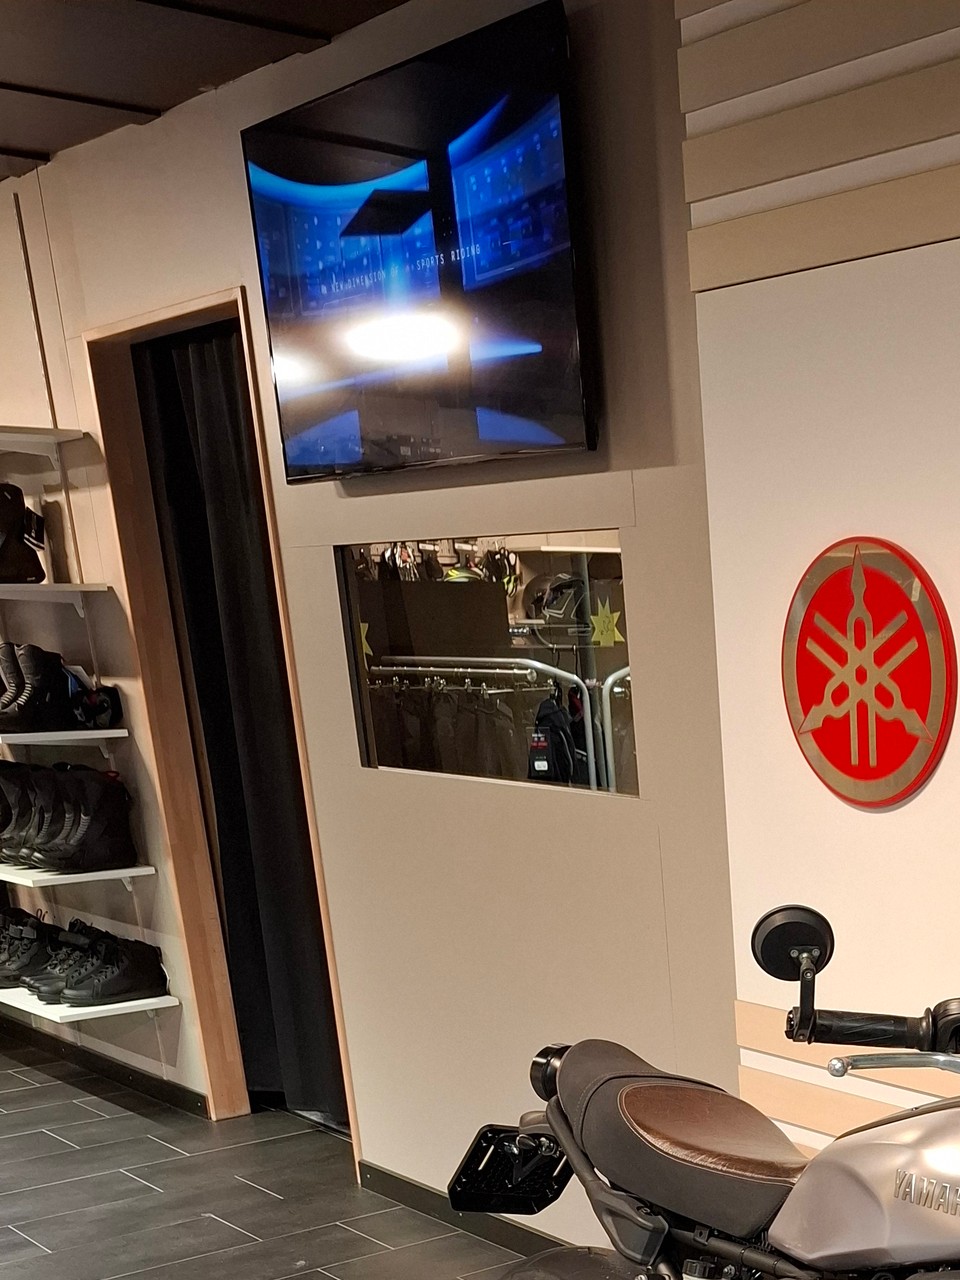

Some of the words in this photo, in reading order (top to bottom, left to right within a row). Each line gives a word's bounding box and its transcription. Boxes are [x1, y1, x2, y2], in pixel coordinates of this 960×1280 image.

[348, 270, 386, 290] DIMENSION
[417, 253, 445, 271] SPORTS
[451, 243, 481, 262] RIDING
